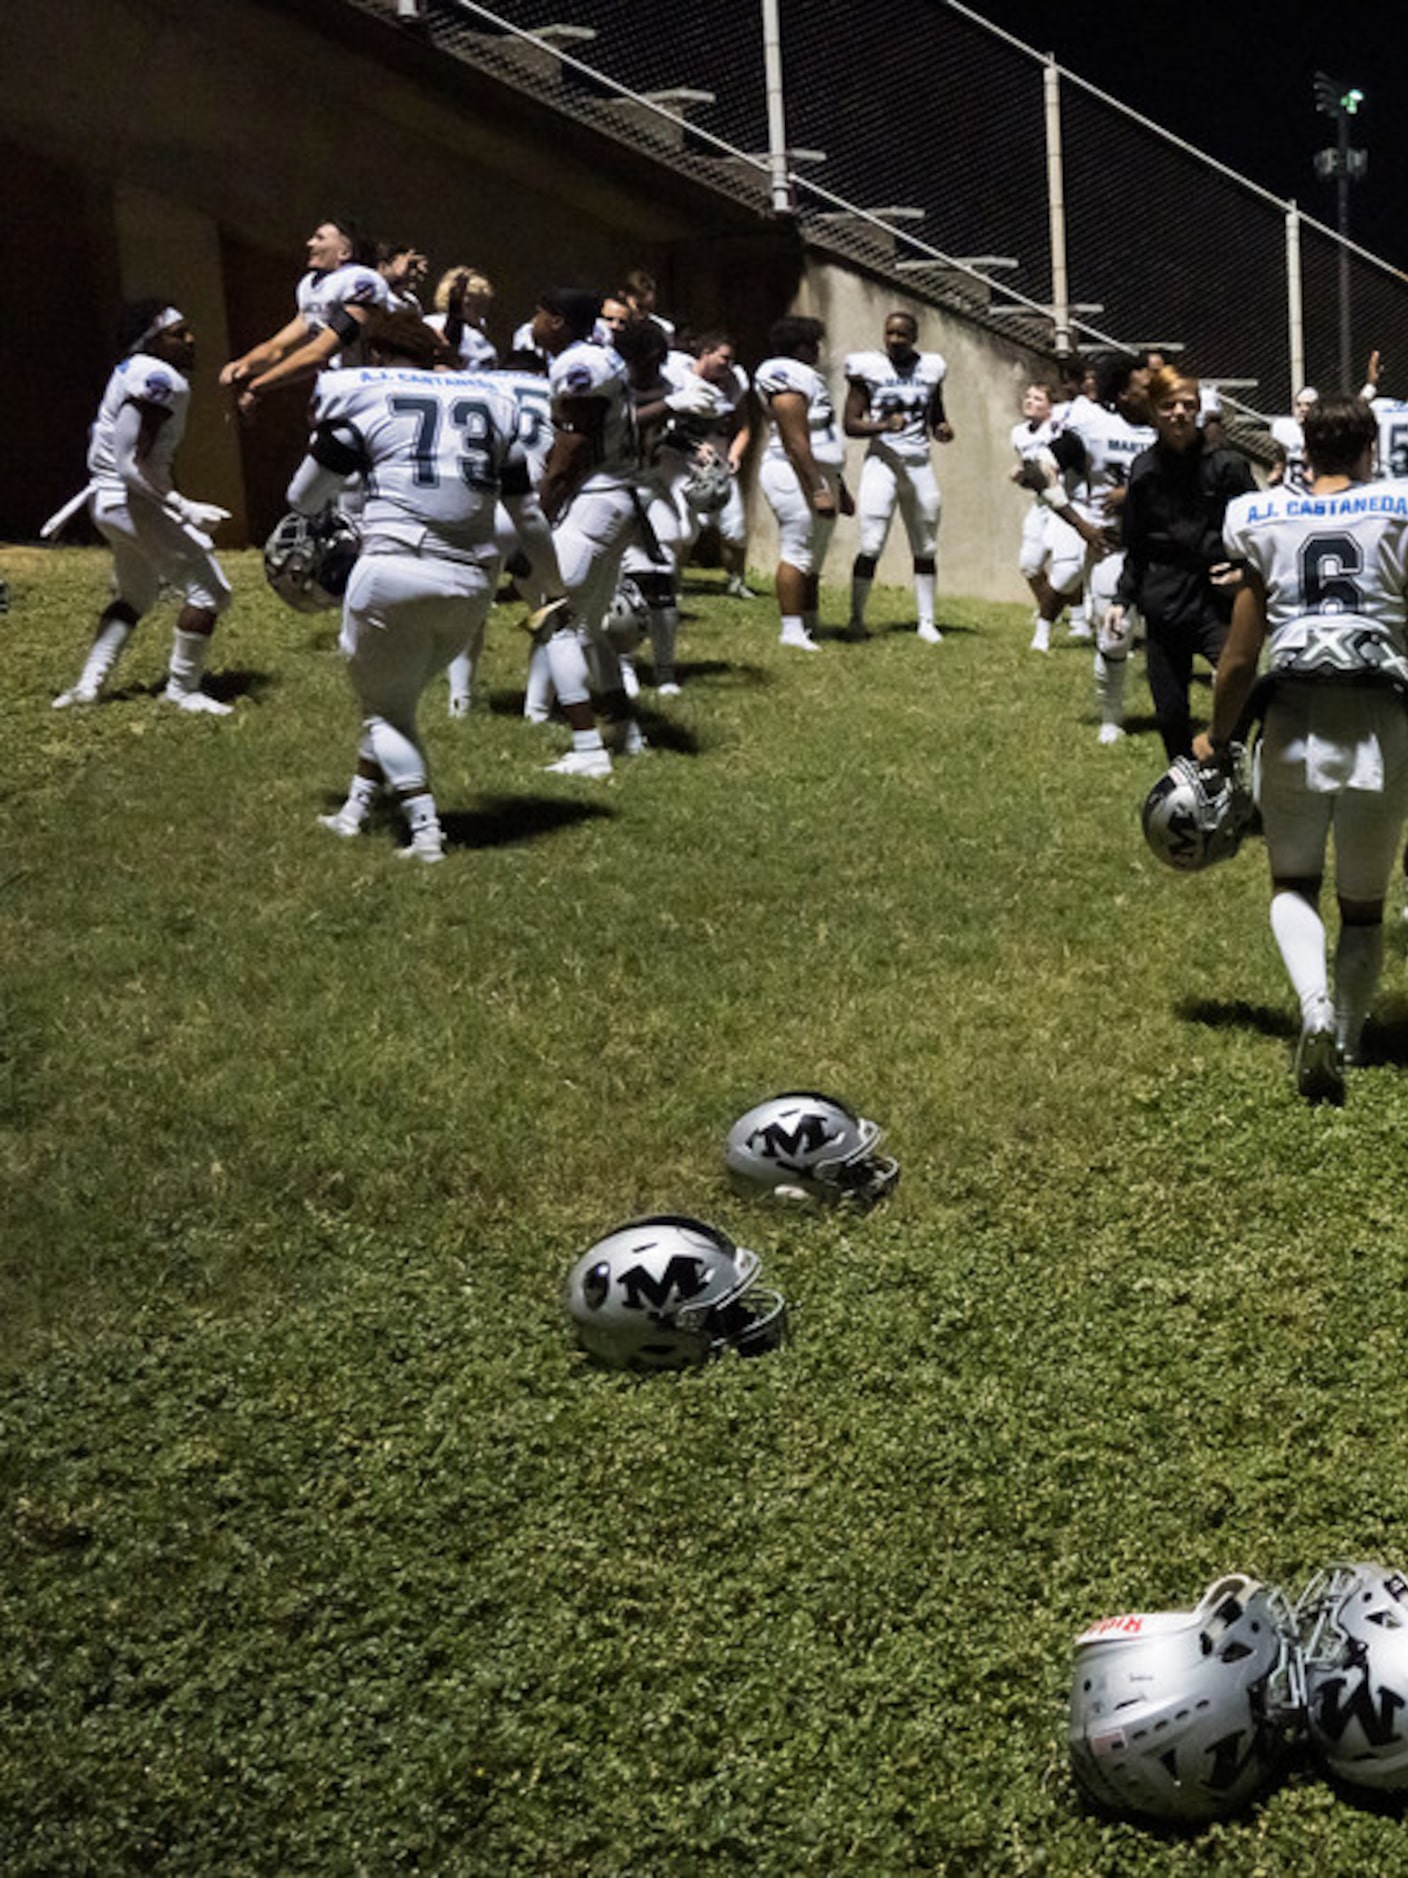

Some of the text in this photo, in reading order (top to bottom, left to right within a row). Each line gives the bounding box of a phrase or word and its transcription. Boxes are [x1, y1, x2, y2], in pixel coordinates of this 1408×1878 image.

[386, 393, 501, 493] 73
[1247, 496, 1408, 524] A.J. CASTANEDA
[1299, 531, 1364, 614] 6
